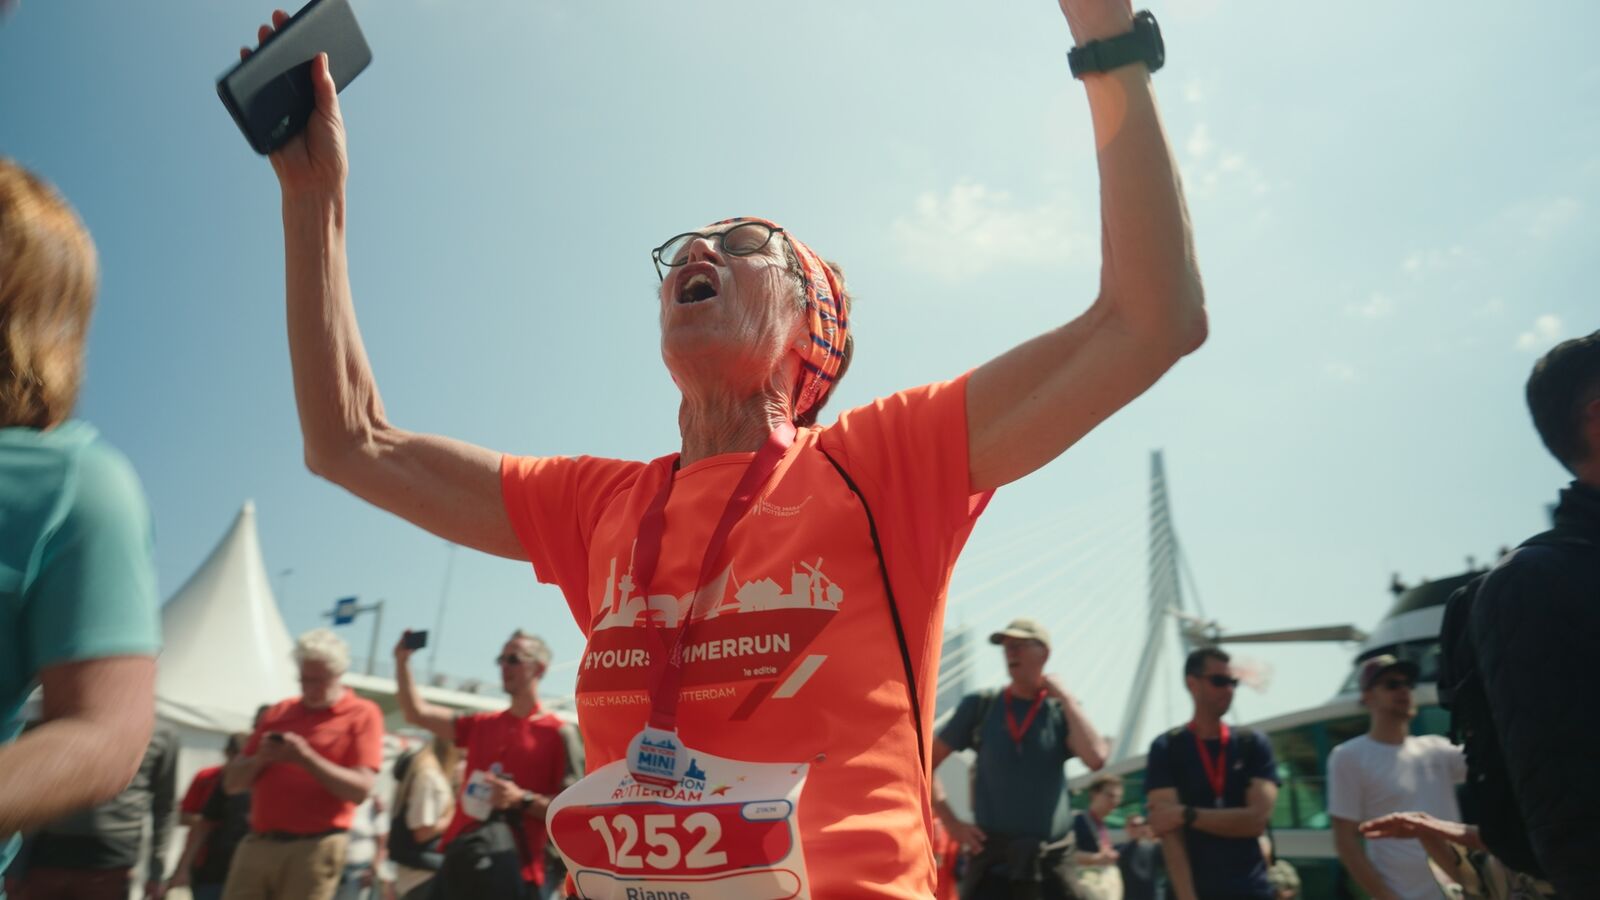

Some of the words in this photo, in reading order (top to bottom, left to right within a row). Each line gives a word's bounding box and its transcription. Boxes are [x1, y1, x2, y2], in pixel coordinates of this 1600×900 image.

[753, 665, 777, 675] editie
[638, 751, 675, 770] MINI
[588, 812, 728, 869] 1252
[625, 887, 691, 900] Rianne
